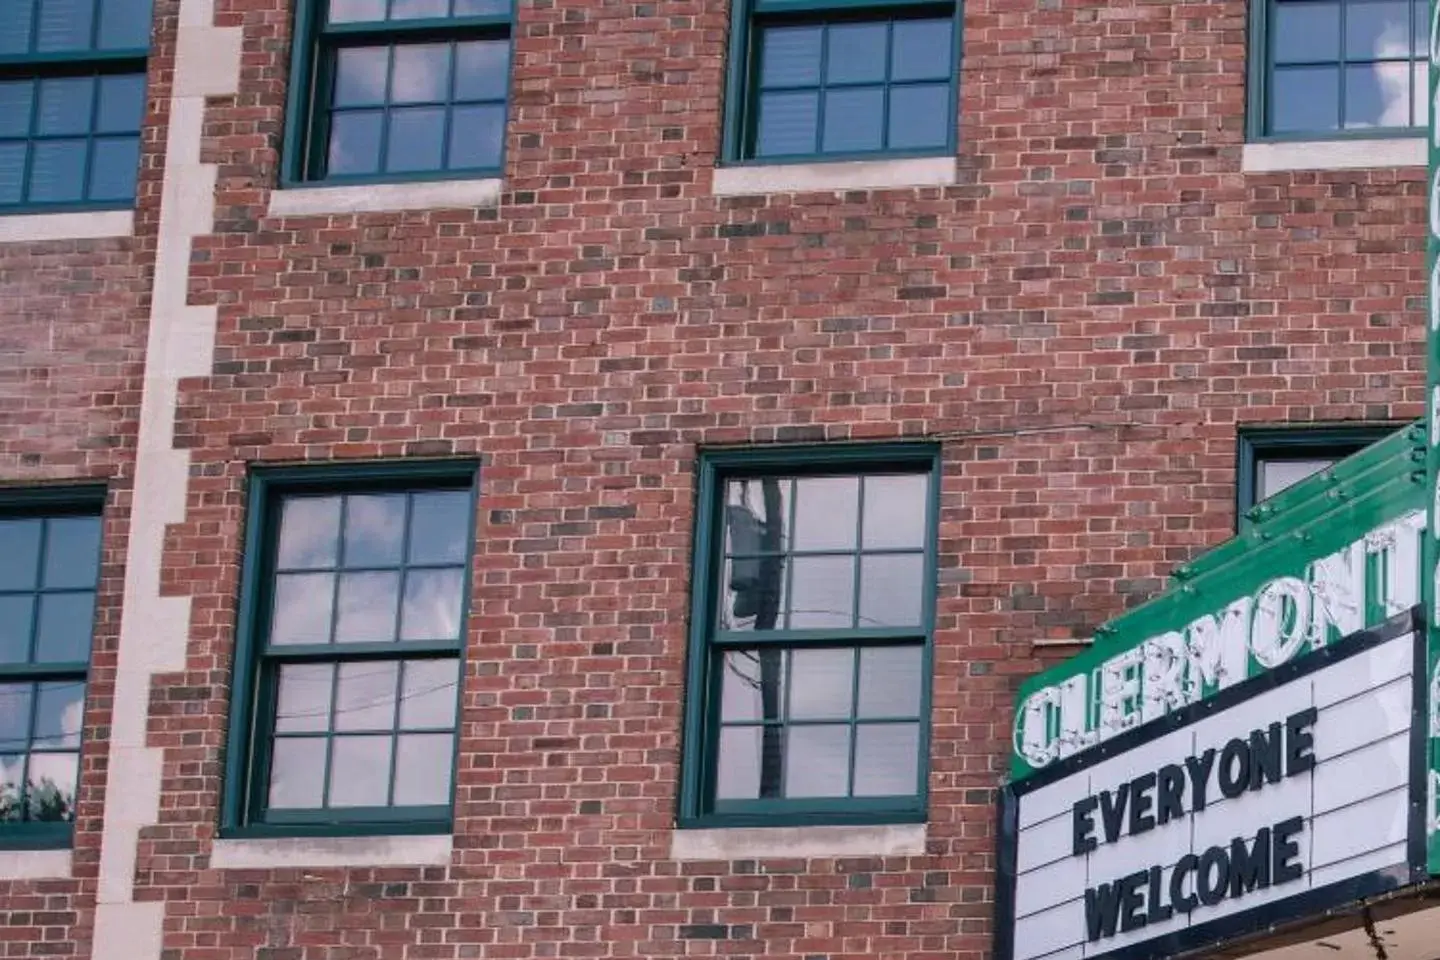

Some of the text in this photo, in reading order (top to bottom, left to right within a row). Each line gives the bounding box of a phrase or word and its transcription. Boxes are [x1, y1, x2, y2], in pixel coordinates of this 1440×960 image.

[1013, 510, 1426, 768] CLERMONT
[1073, 706, 1317, 857] EVERYONE
[1083, 815, 1305, 942] WELCOME
